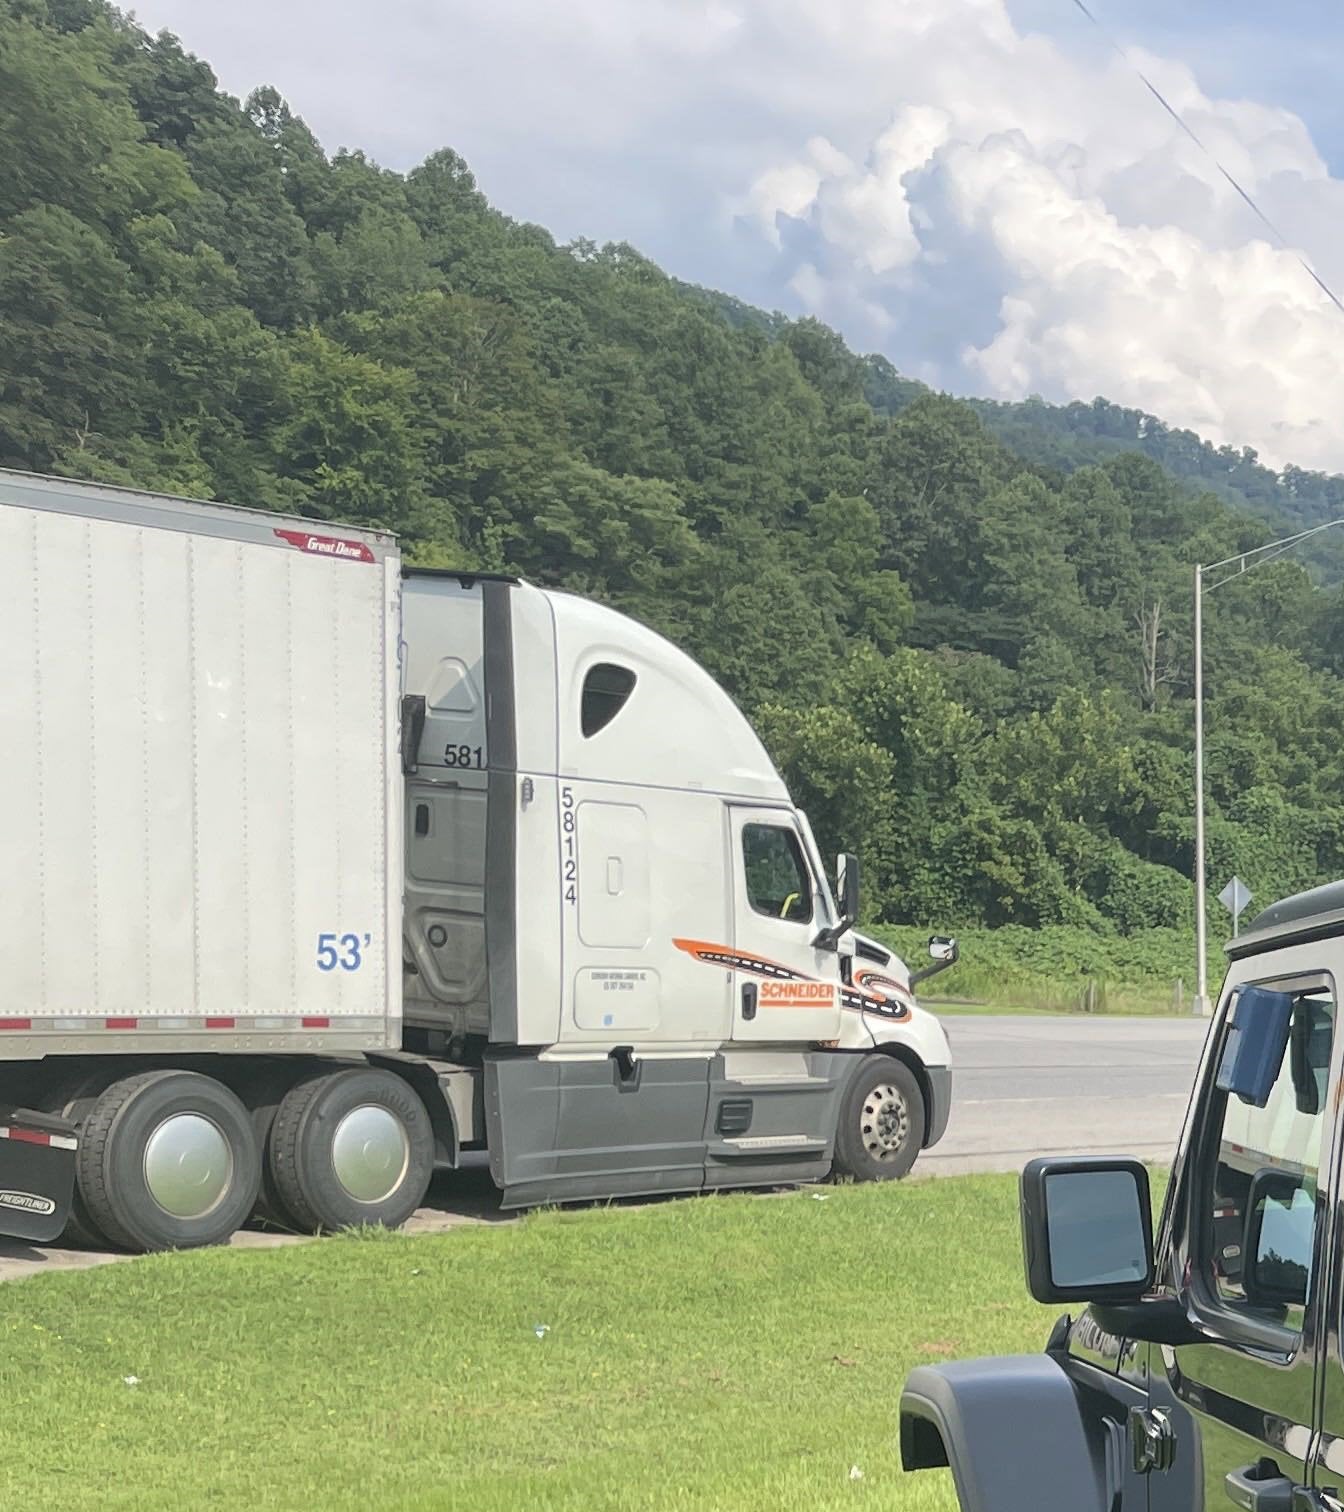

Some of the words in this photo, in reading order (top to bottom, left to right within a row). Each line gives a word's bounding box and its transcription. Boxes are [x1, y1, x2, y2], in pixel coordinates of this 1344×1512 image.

[307, 537, 335, 551] Great
[335, 542, 361, 556] Dane
[443, 744, 483, 769] 581
[562, 786, 577, 906] 58124
[760, 982, 835, 999] SCHNEIDER
